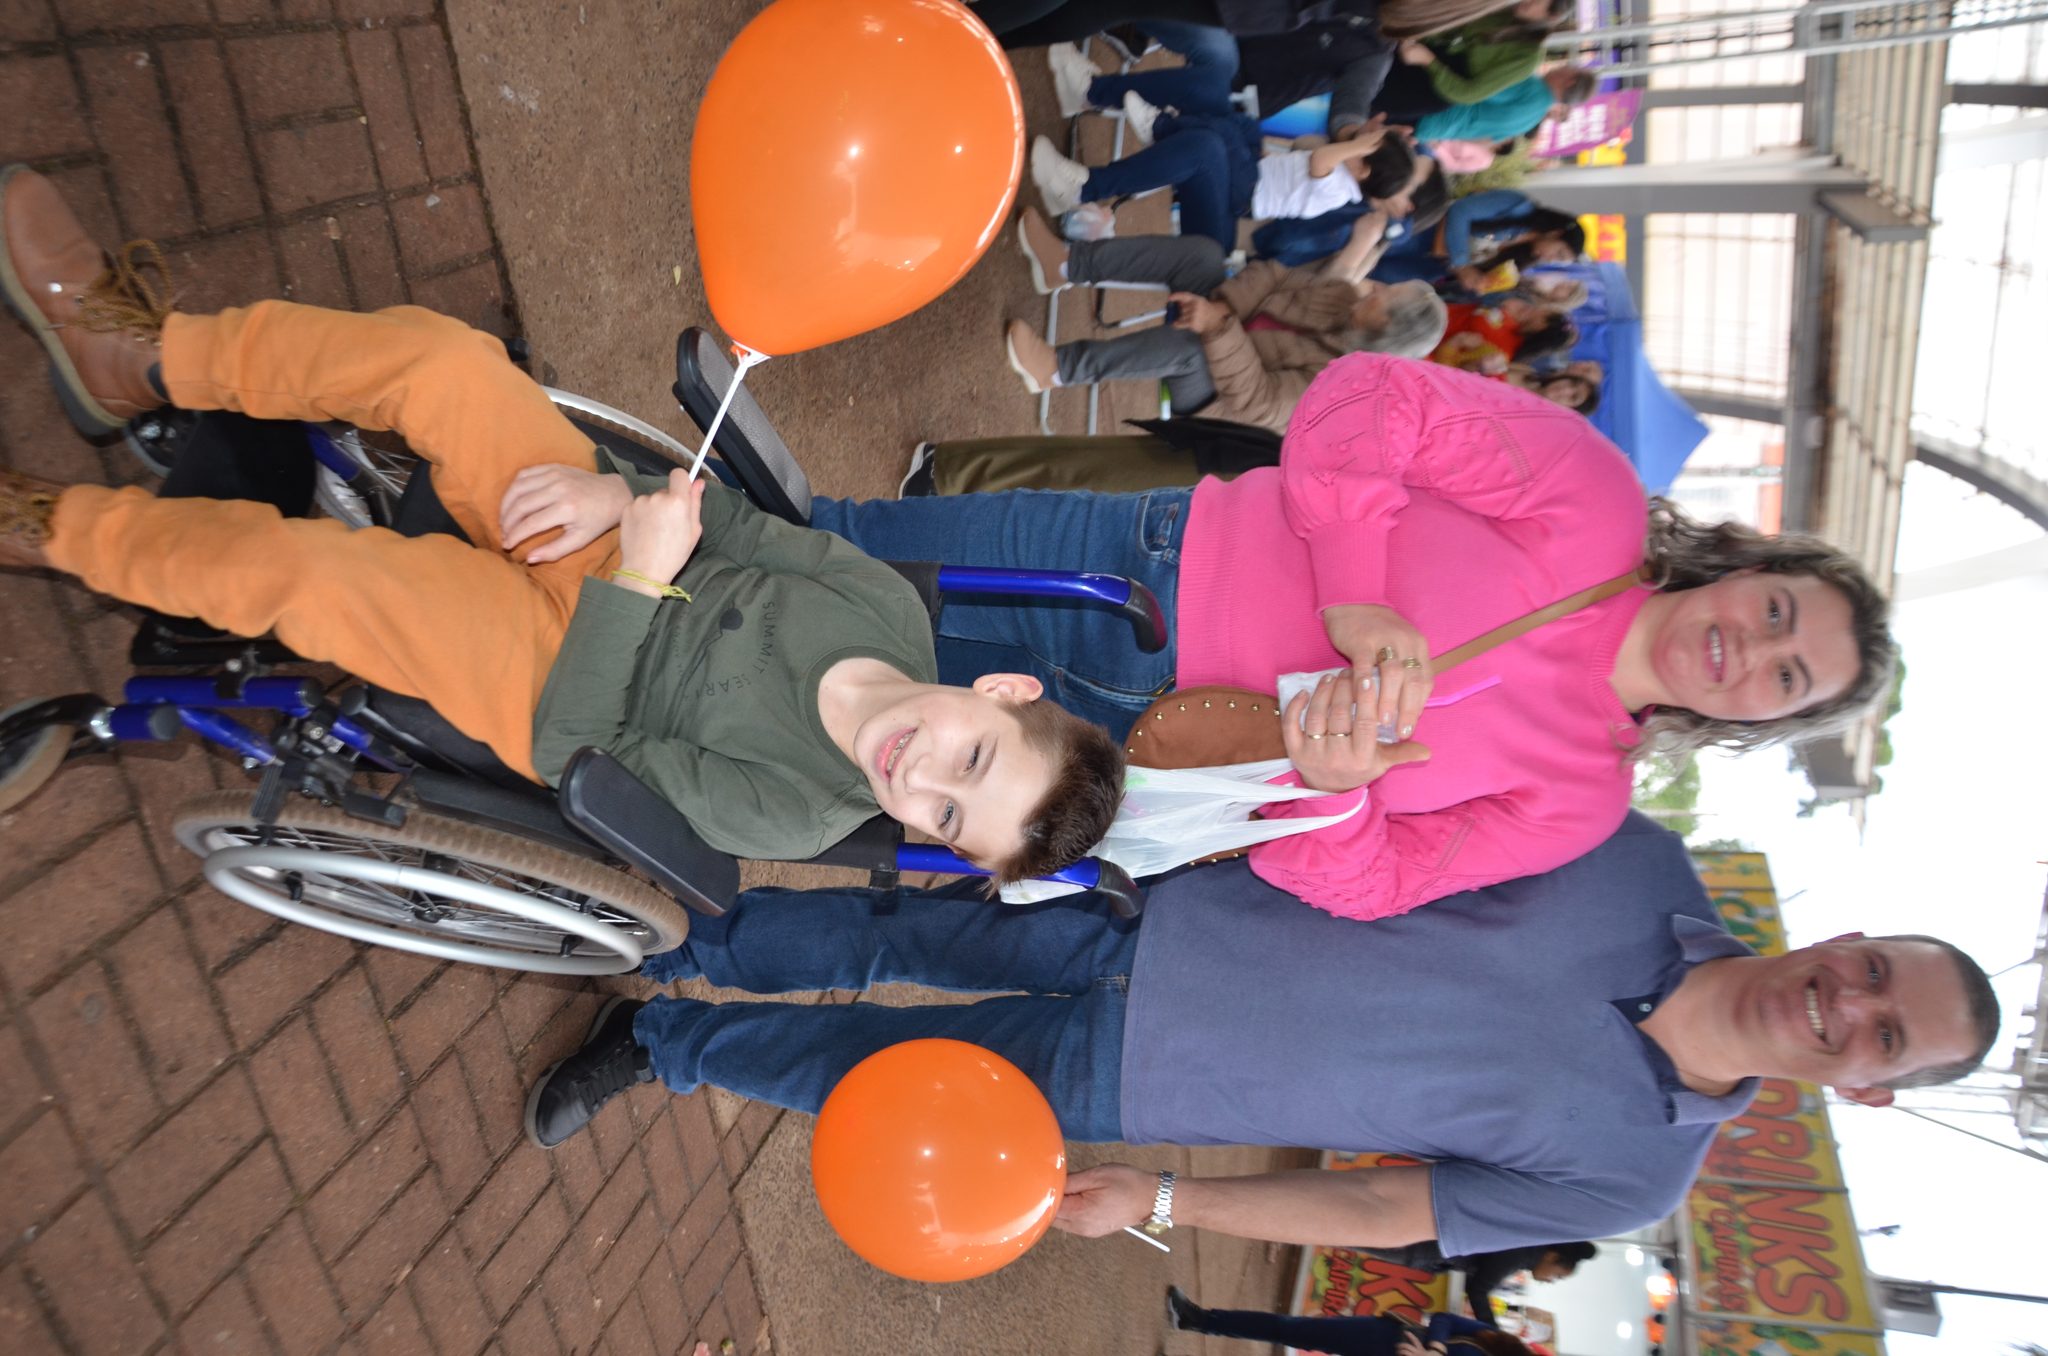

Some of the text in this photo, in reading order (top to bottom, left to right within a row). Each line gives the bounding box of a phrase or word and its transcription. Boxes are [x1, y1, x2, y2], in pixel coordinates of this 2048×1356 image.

[752, 601, 776, 675] SUMMIT
[1732, 1080, 1850, 1322] DRINKS
[1710, 1208, 1750, 1312] CAIPIRAS
